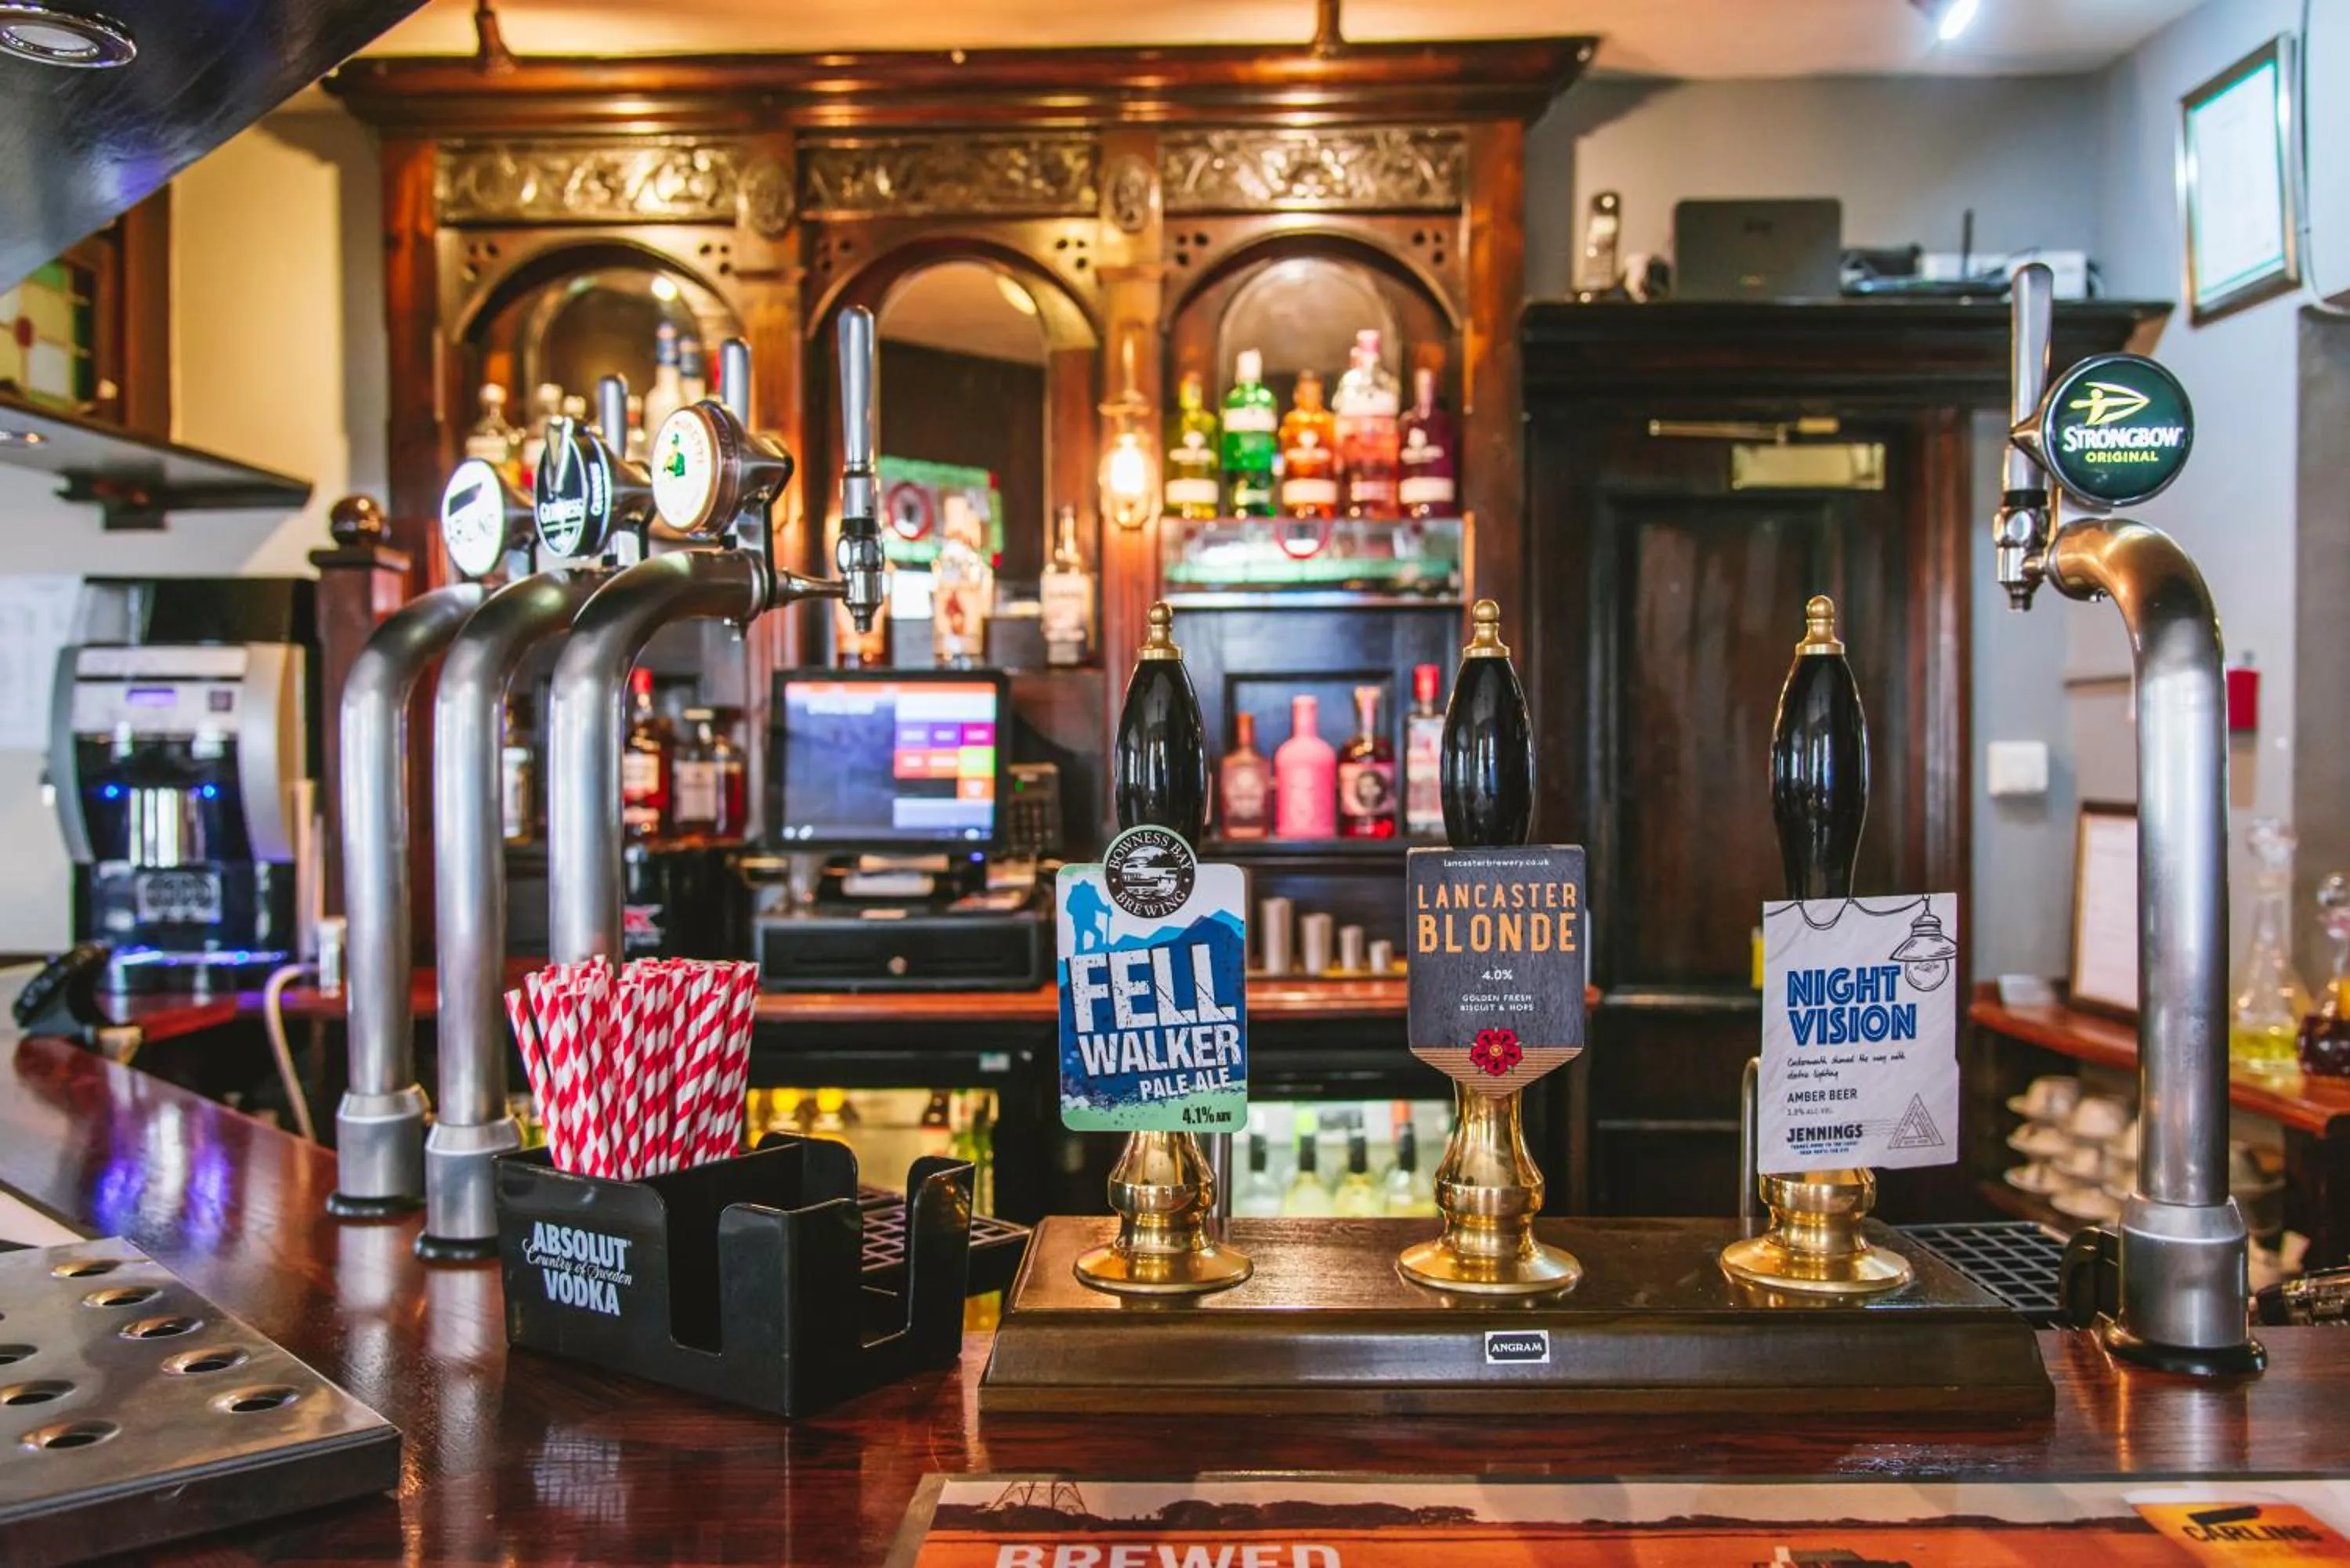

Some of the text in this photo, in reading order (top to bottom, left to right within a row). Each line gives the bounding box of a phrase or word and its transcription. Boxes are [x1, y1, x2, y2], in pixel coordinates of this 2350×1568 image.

[2063, 425, 2182, 452] STRONGBOW
[2085, 451, 2159, 463] ORIGINAL
[1108, 832, 1192, 869] BOWNESS BAY
[1116, 890, 1186, 916] BREWING
[1417, 883, 1578, 909] LANCASTER
[1417, 912, 1577, 953] BLONDE
[1070, 944, 1236, 1033] FELL
[1481, 969, 1513, 980] 4.0%
[1787, 965, 1901, 1007] NIGHT
[1788, 1003, 1916, 1046] VISION
[1078, 1024, 1241, 1077] WALKER
[1140, 1067, 1232, 1100] PALE ALE
[1787, 1088, 1857, 1103] AMBER BEER
[1182, 1105, 1215, 1125] 4.1%
[1787, 1124, 1863, 1143] JENNINGS
[522, 1237, 572, 1272] Country
[533, 1221, 627, 1270] ABSOLUT
[542, 1268, 621, 1317] VODKA
[1491, 1342, 1542, 1353] ANGRAM
